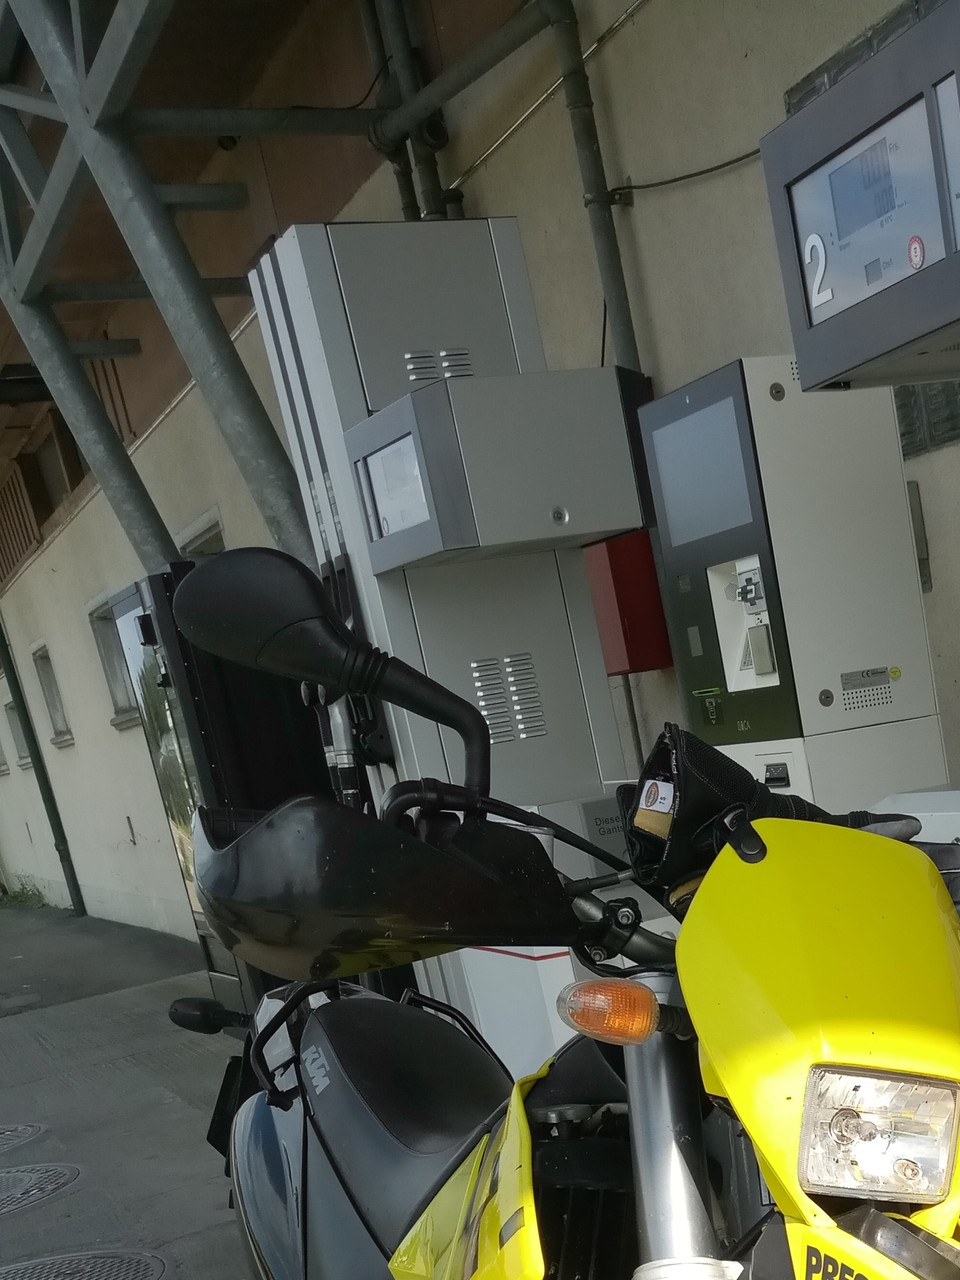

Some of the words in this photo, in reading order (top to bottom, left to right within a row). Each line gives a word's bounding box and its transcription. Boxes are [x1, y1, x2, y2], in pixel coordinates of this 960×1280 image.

[804, 233, 834, 308] 2
[594, 815, 623, 827] Diese
[301, 1045, 330, 1096] KTM
